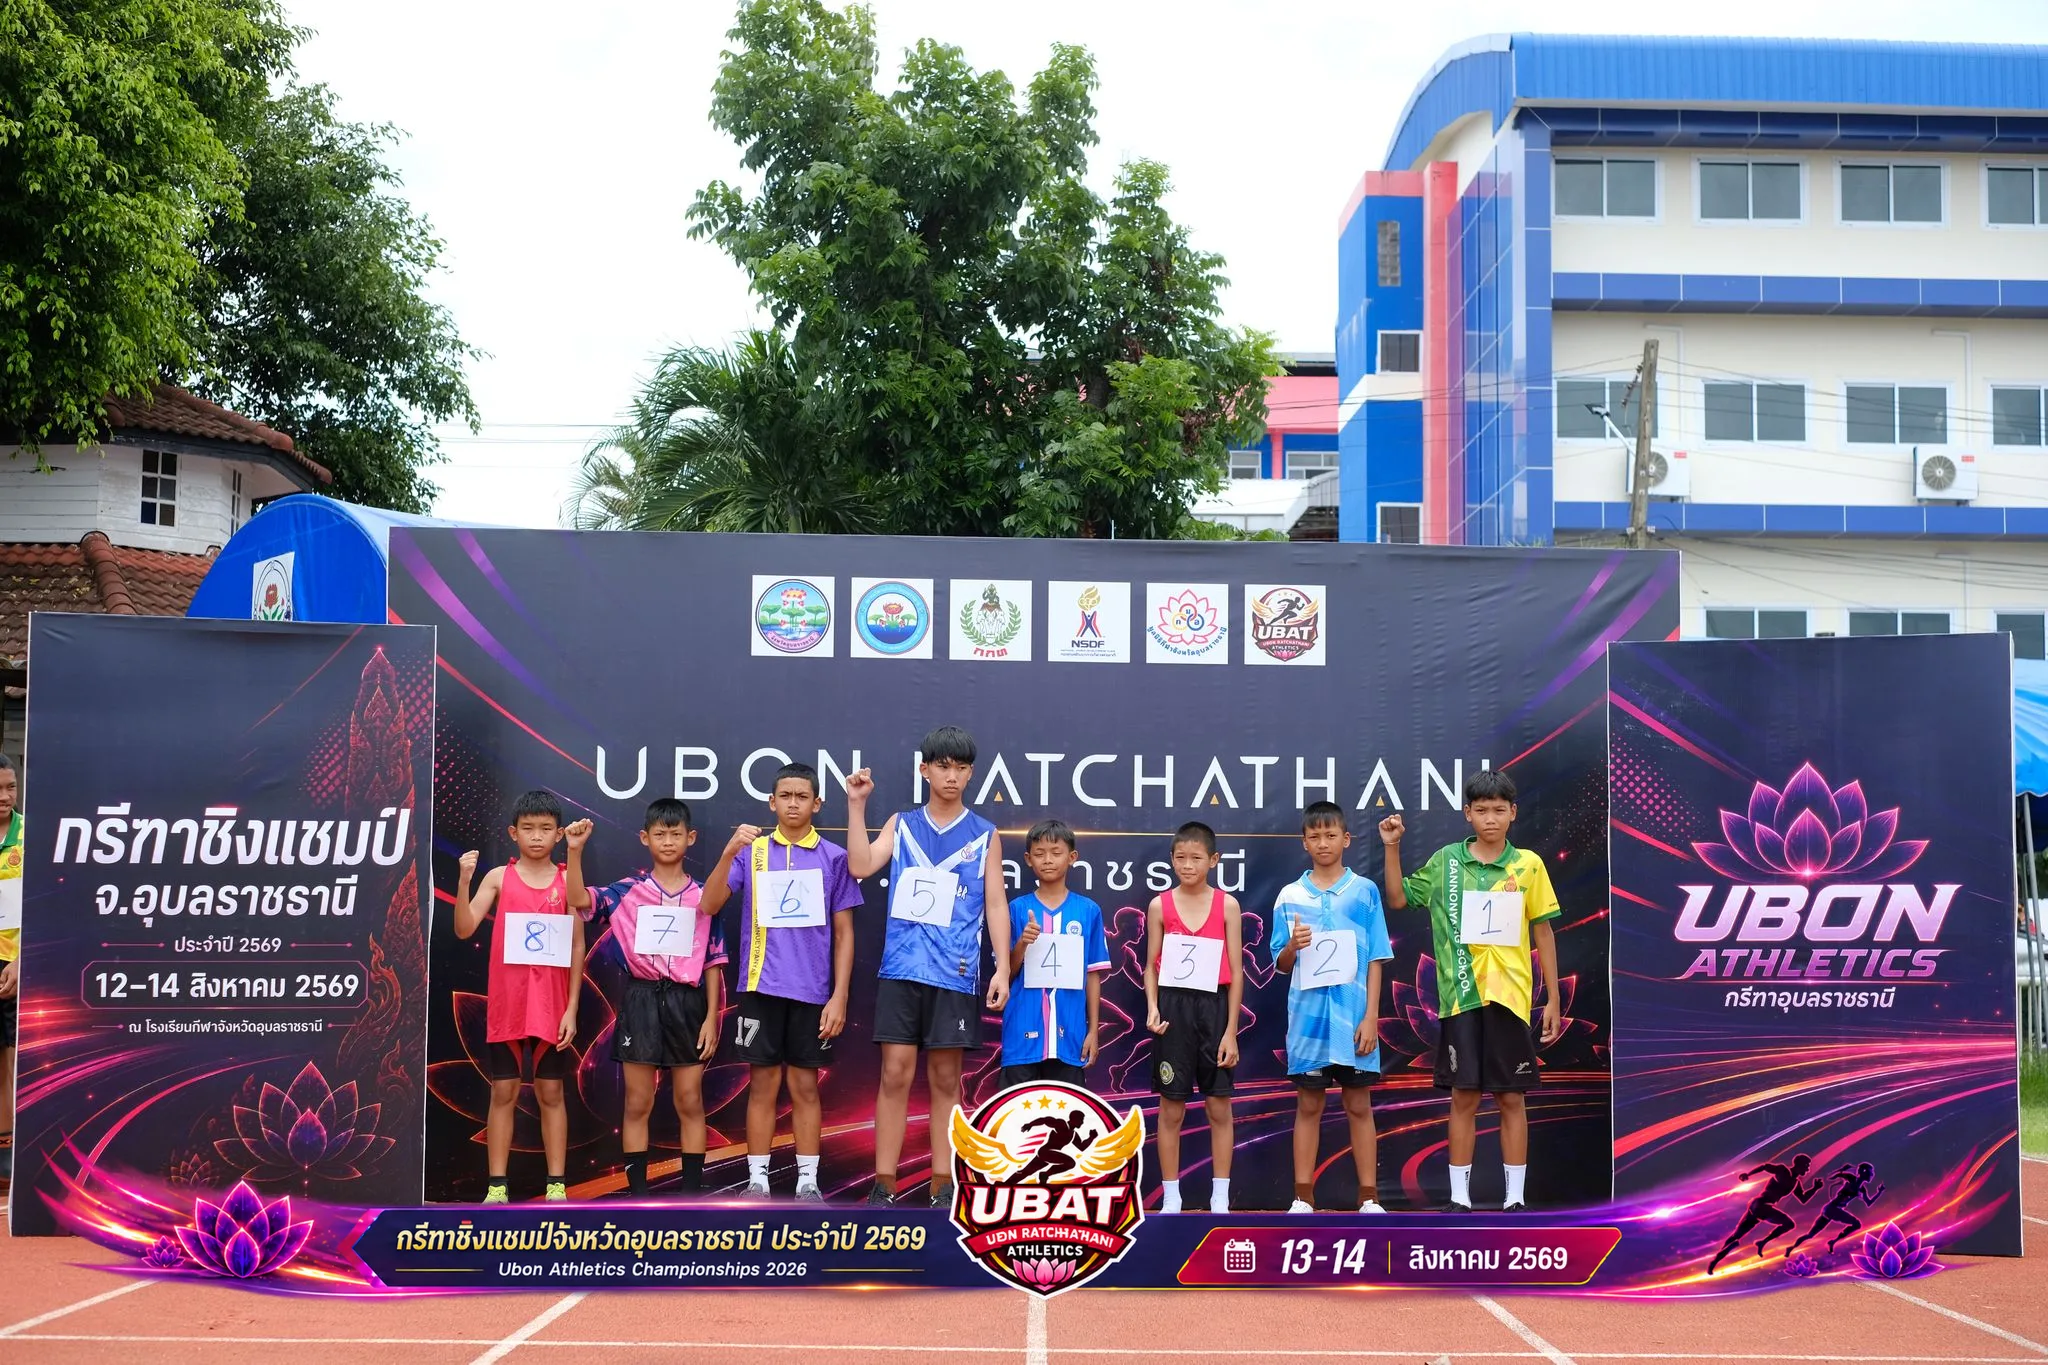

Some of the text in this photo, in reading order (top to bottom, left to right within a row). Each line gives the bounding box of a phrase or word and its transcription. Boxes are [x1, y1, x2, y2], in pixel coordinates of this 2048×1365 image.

[1071, 640, 1105, 648] NSDF
[1257, 625, 1314, 640] UBAT
[596, 745, 1490, 811] UBON ATCHATHAN
[53, 802, 411, 866] กรีฑาชิงแชมป์
[95, 874, 359, 928] จ.อุบลราชธานี
[780, 879, 801, 914] 6
[910, 879, 937, 918] 5
[1674, 883, 1963, 942] UBON
[652, 914, 679, 945] 7
[1481, 899, 1502, 935] 1
[174, 935, 282, 953] ประจำปี 2569
[524, 920, 547, 952] 8
[1040, 941, 1062, 978] 4
[1173, 943, 1197, 981] 3
[1313, 938, 1340, 976] 2
[1456, 948, 1470, 998] SCHOOL
[1684, 948, 1950, 978] ATHLETICS
[189, 972, 286, 998] สิงหาคม
[295, 973, 360, 998] 2569
[1724, 985, 1896, 1013] กรีฑาอุบลราชธานี
[145, 1018, 323, 1036] โรงเรียนกีฬาจังหวัดอุบลราชธานี
[735, 1016, 761, 1048] 17
